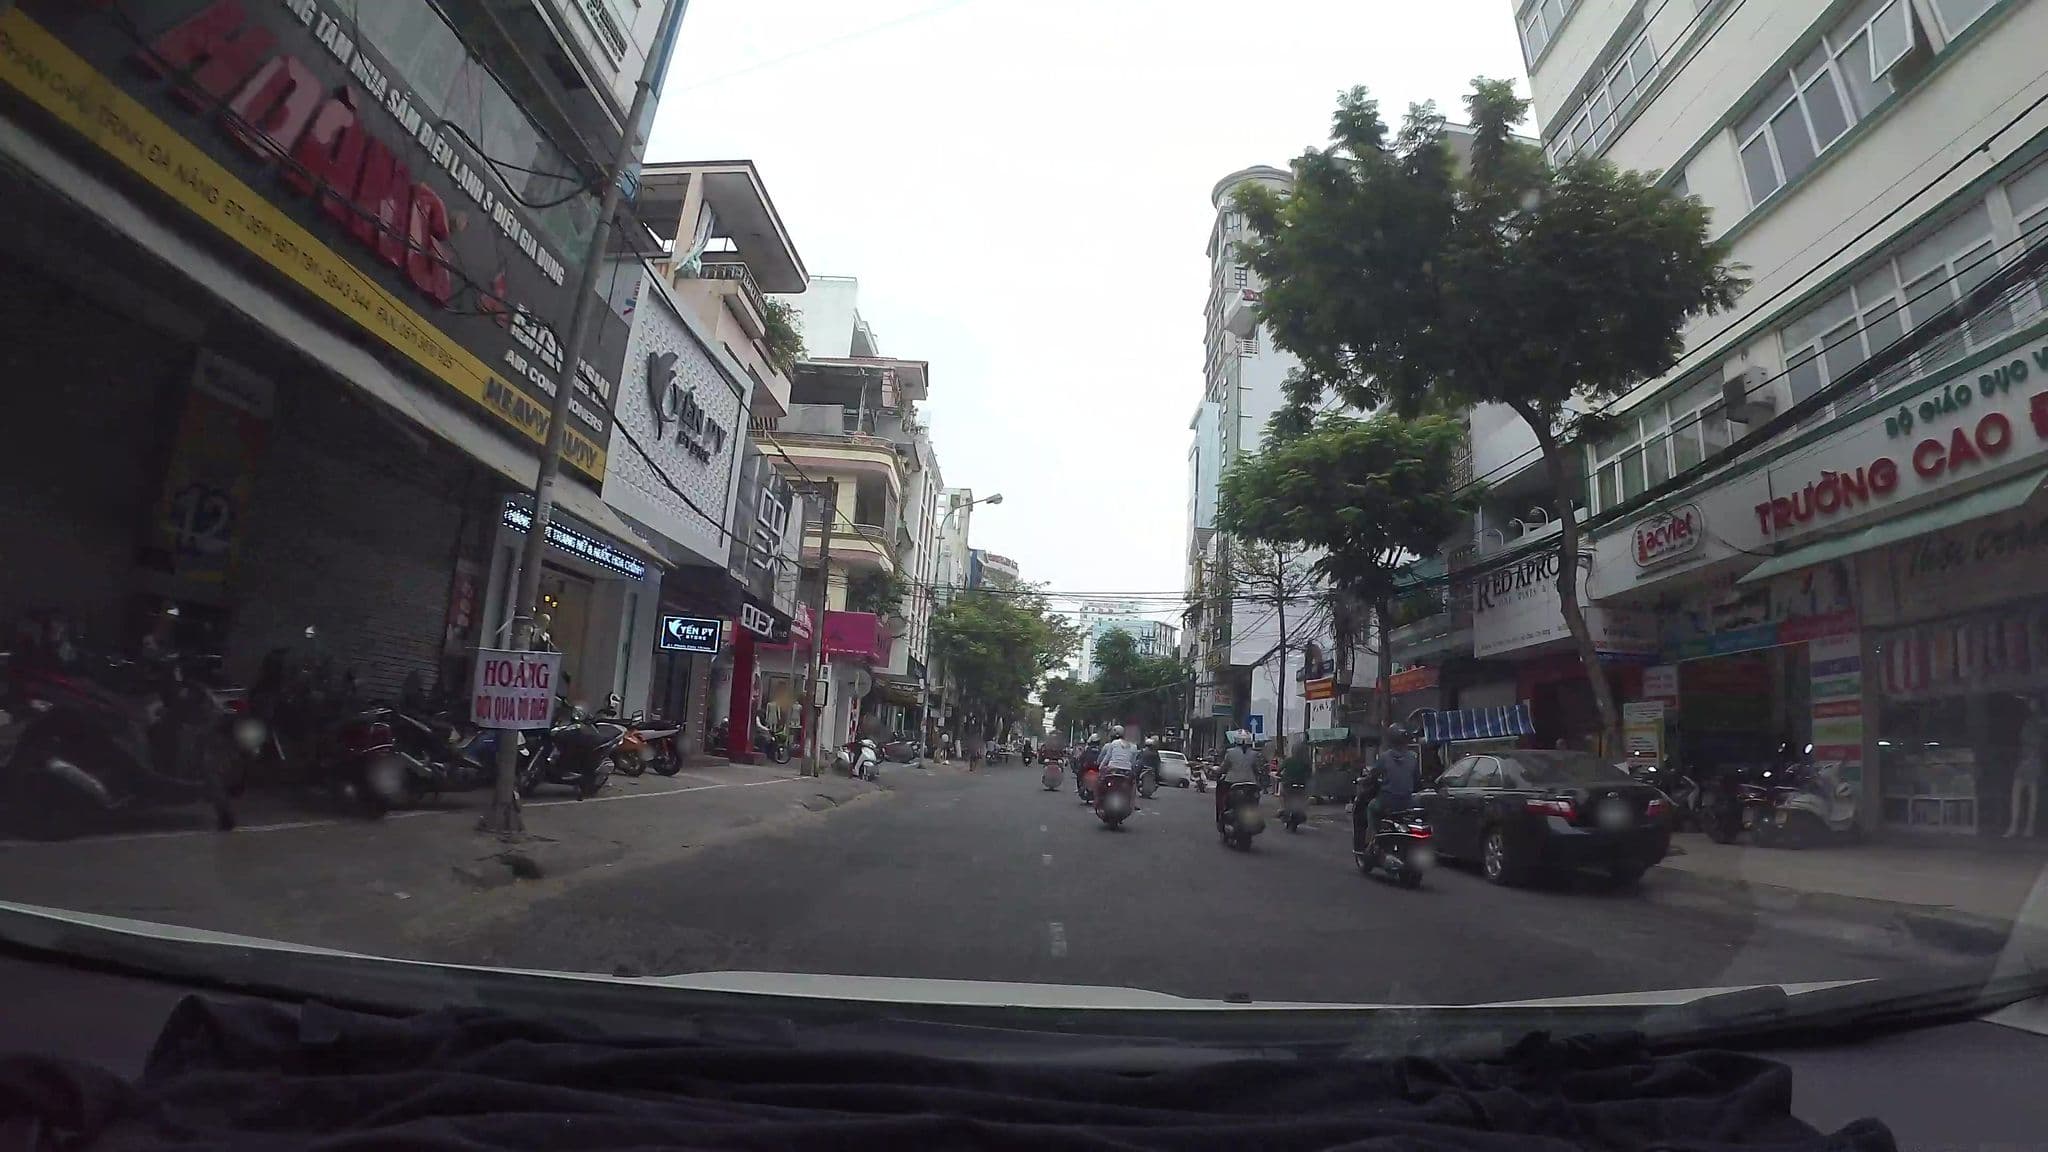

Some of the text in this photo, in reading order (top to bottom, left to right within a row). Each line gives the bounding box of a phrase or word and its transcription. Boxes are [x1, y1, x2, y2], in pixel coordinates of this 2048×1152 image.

[313, 9, 354, 64] TÂM
[349, 49, 388, 103] MUA
[449, 155, 486, 203] LẠNH
[482, 190, 495, 213] &
[516, 231, 539, 260] GIA
[504, 349, 529, 376] AIR
[1885, 405, 1914, 439] BỘ
[1918, 384, 1973, 423] GIÁO
[1754, 456, 1899, 536] TRƯỜNG
[1912, 411, 2013, 479] CAO
[1514, 549, 1562, 588] APRO
[494, 695, 515, 722] QUA
